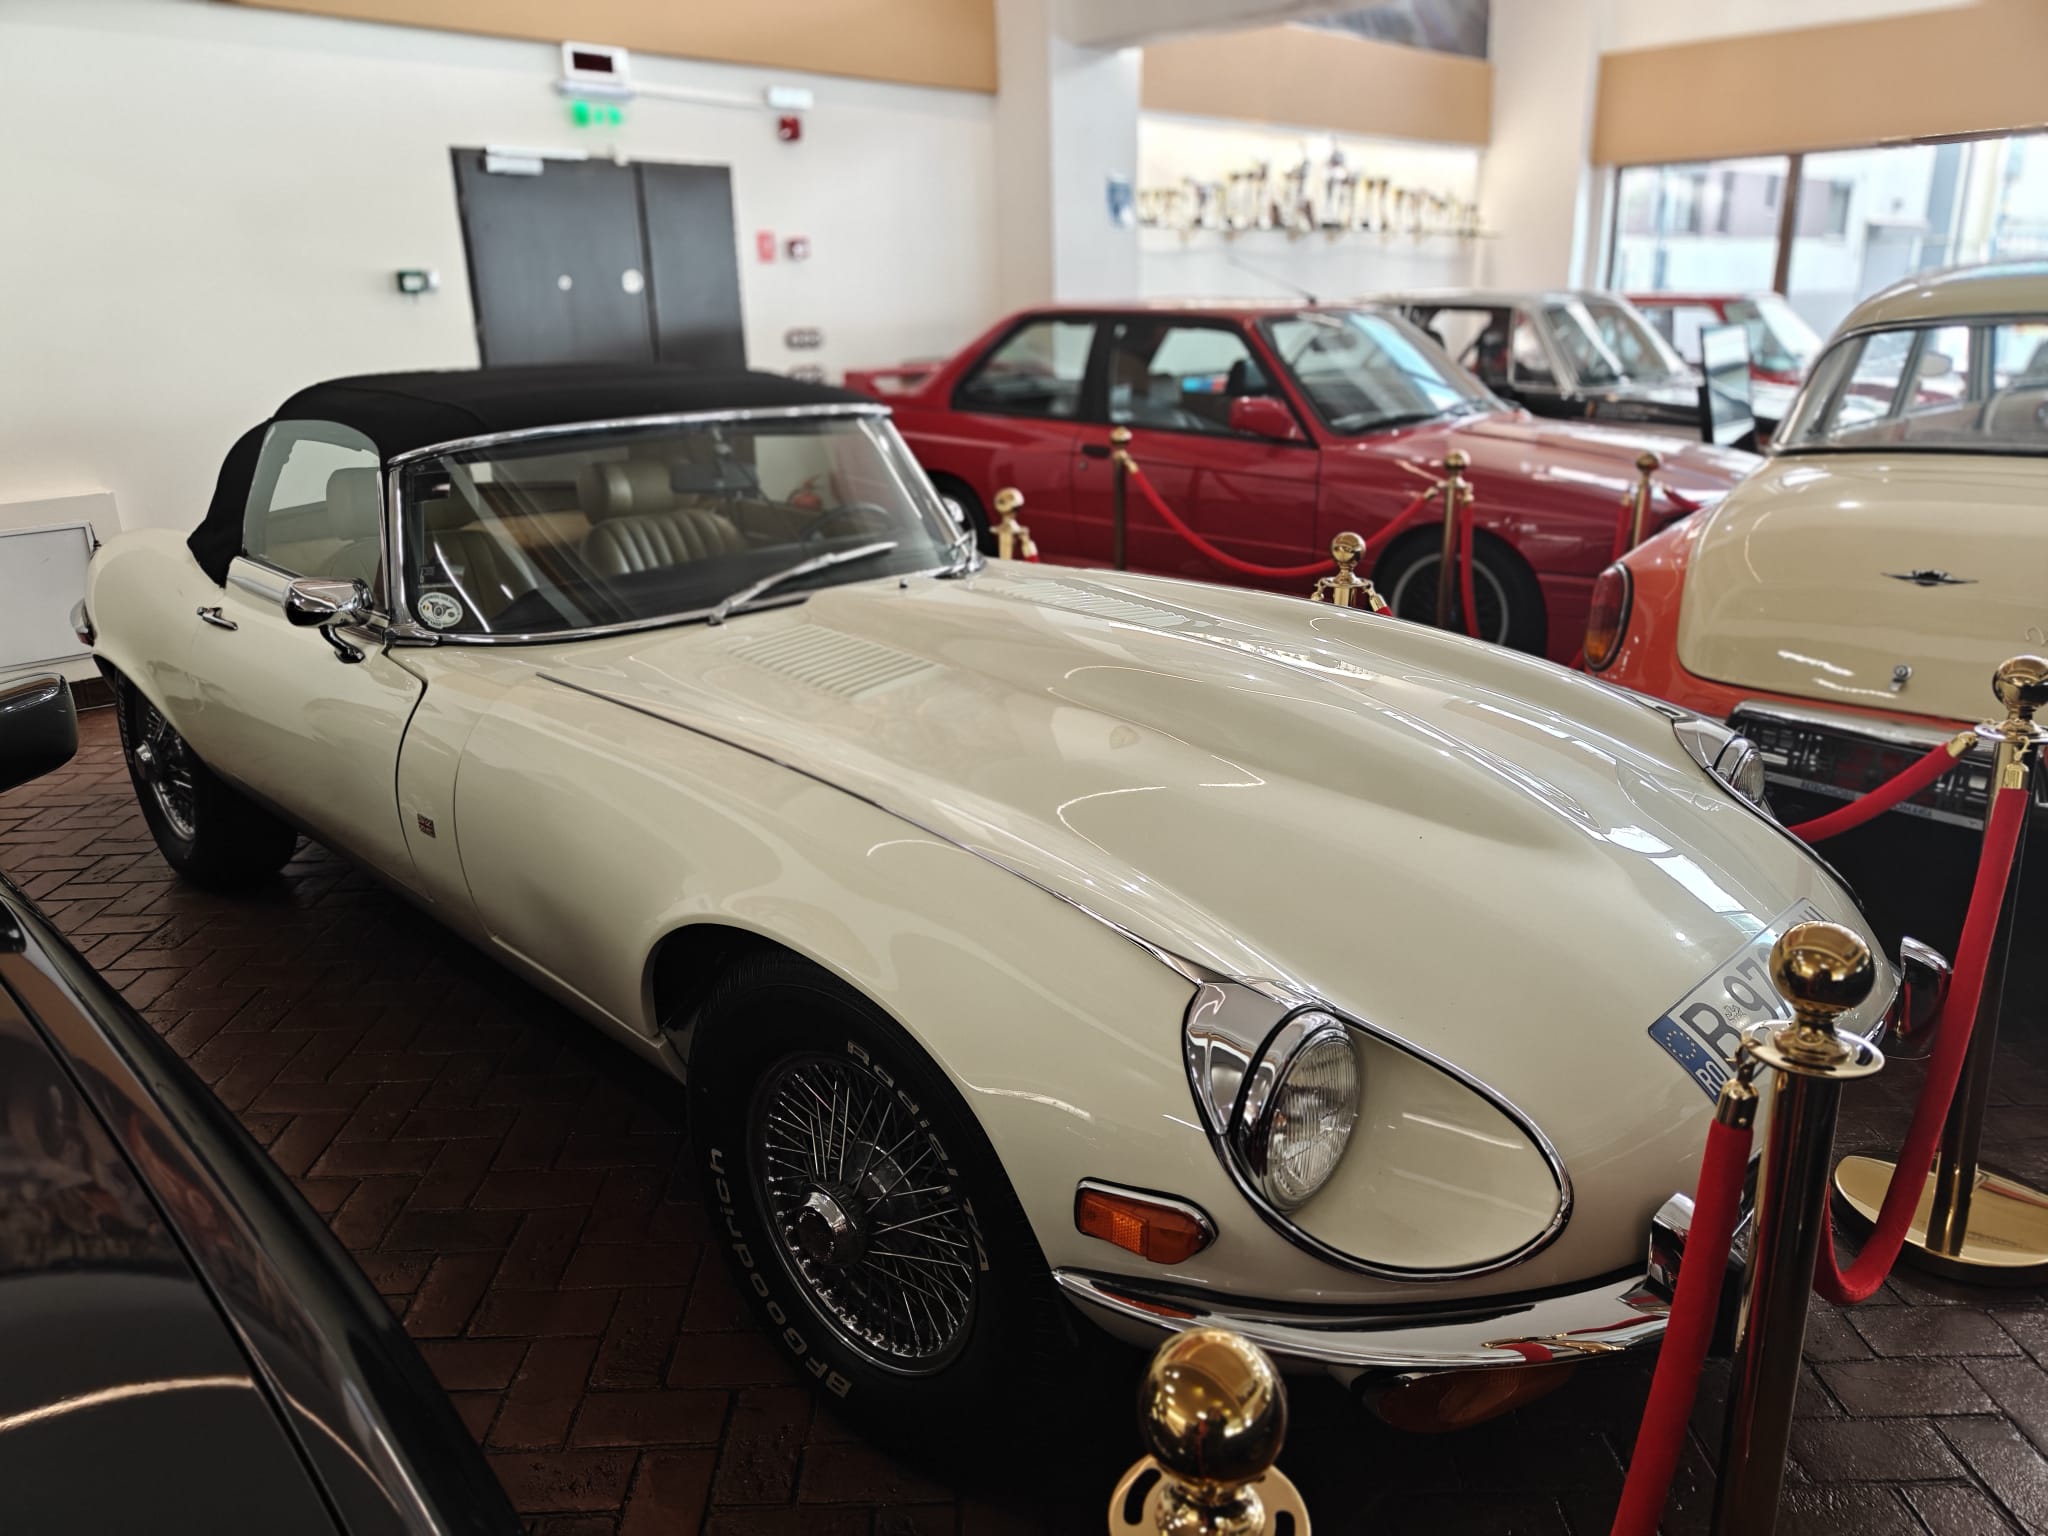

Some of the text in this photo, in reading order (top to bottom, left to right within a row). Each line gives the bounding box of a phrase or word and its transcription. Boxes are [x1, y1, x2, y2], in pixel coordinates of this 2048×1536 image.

[847, 1040, 958, 1176] Radial
[1694, 1060, 1728, 1096] RO
[710, 1147, 853, 1398] BFGoodrich
